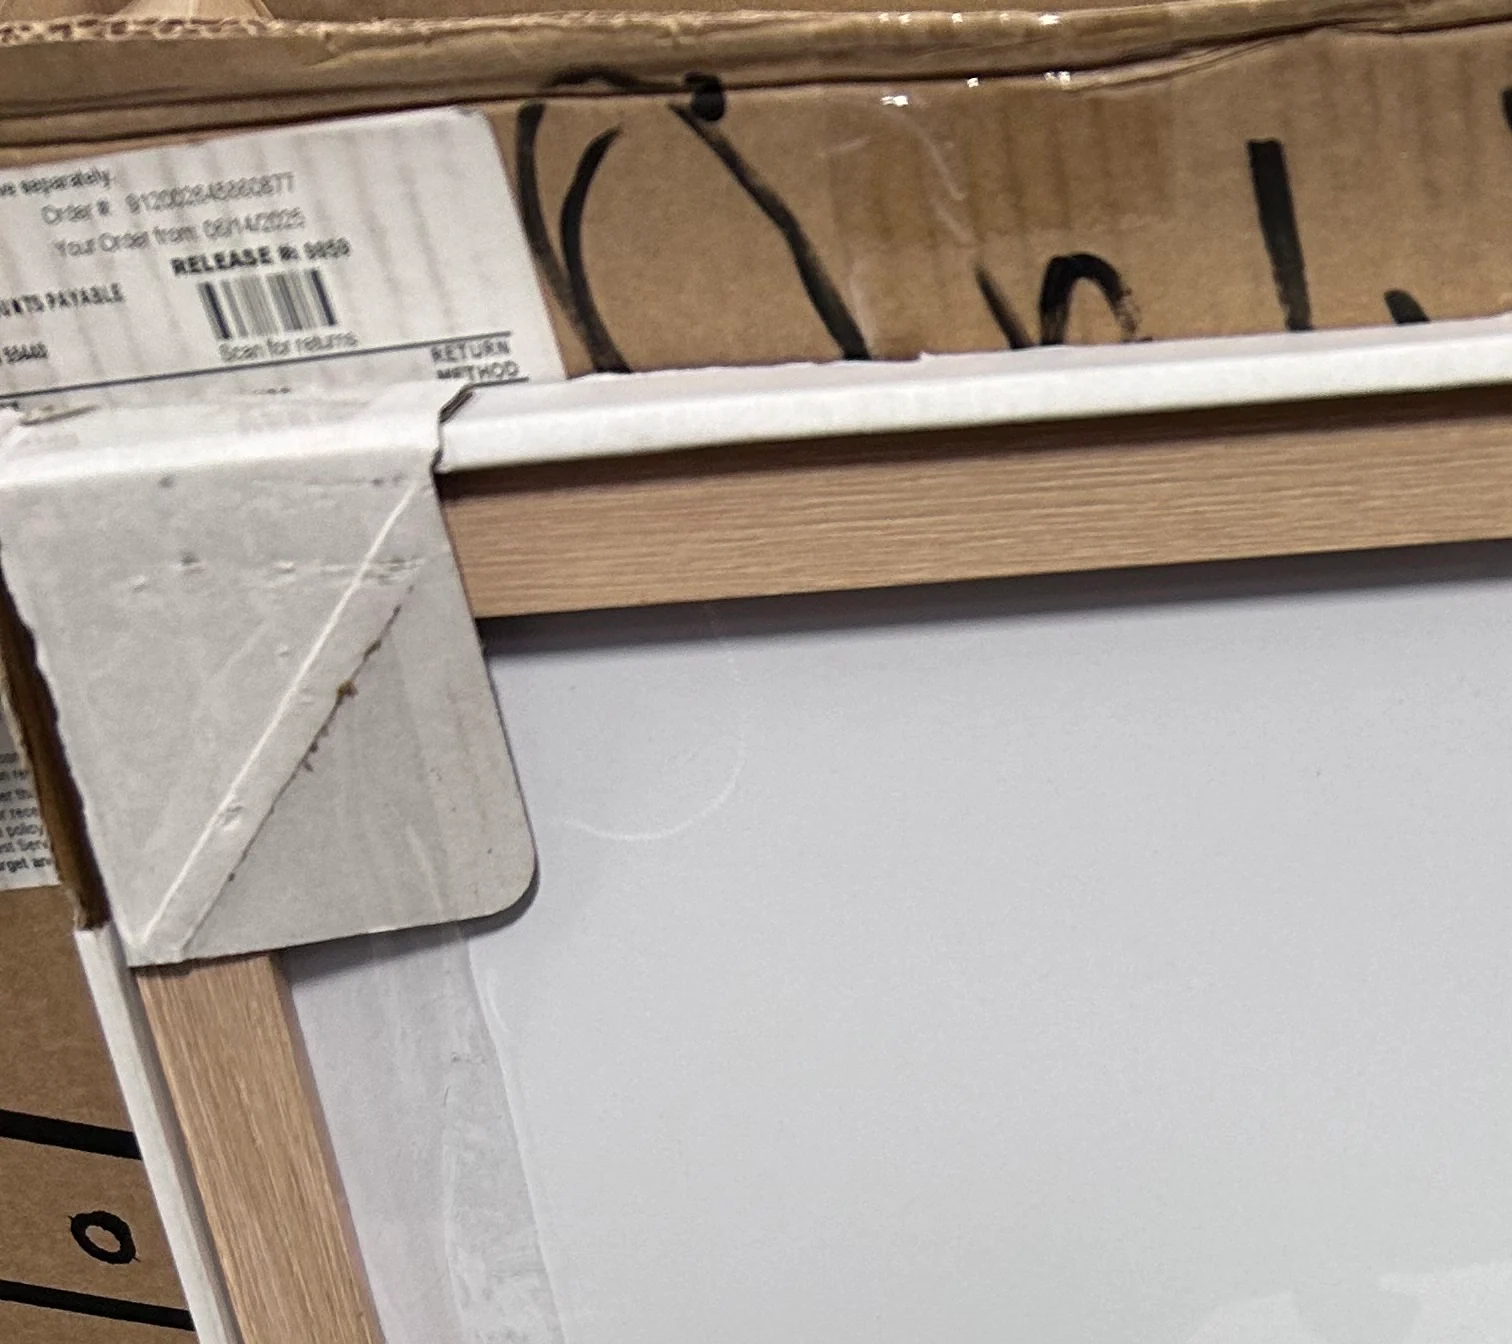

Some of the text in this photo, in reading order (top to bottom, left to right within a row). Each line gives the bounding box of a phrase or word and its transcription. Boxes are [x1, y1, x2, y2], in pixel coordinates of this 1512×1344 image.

[41, 202, 93, 225] Order
[52, 238, 96, 258] Your
[98, 230, 150, 253] Order
[169, 244, 273, 278] RELEASE
[45, 282, 125, 312] PAYABLE
[218, 330, 361, 364] Scan for returns
[430, 340, 521, 381] RETURN METHOD
